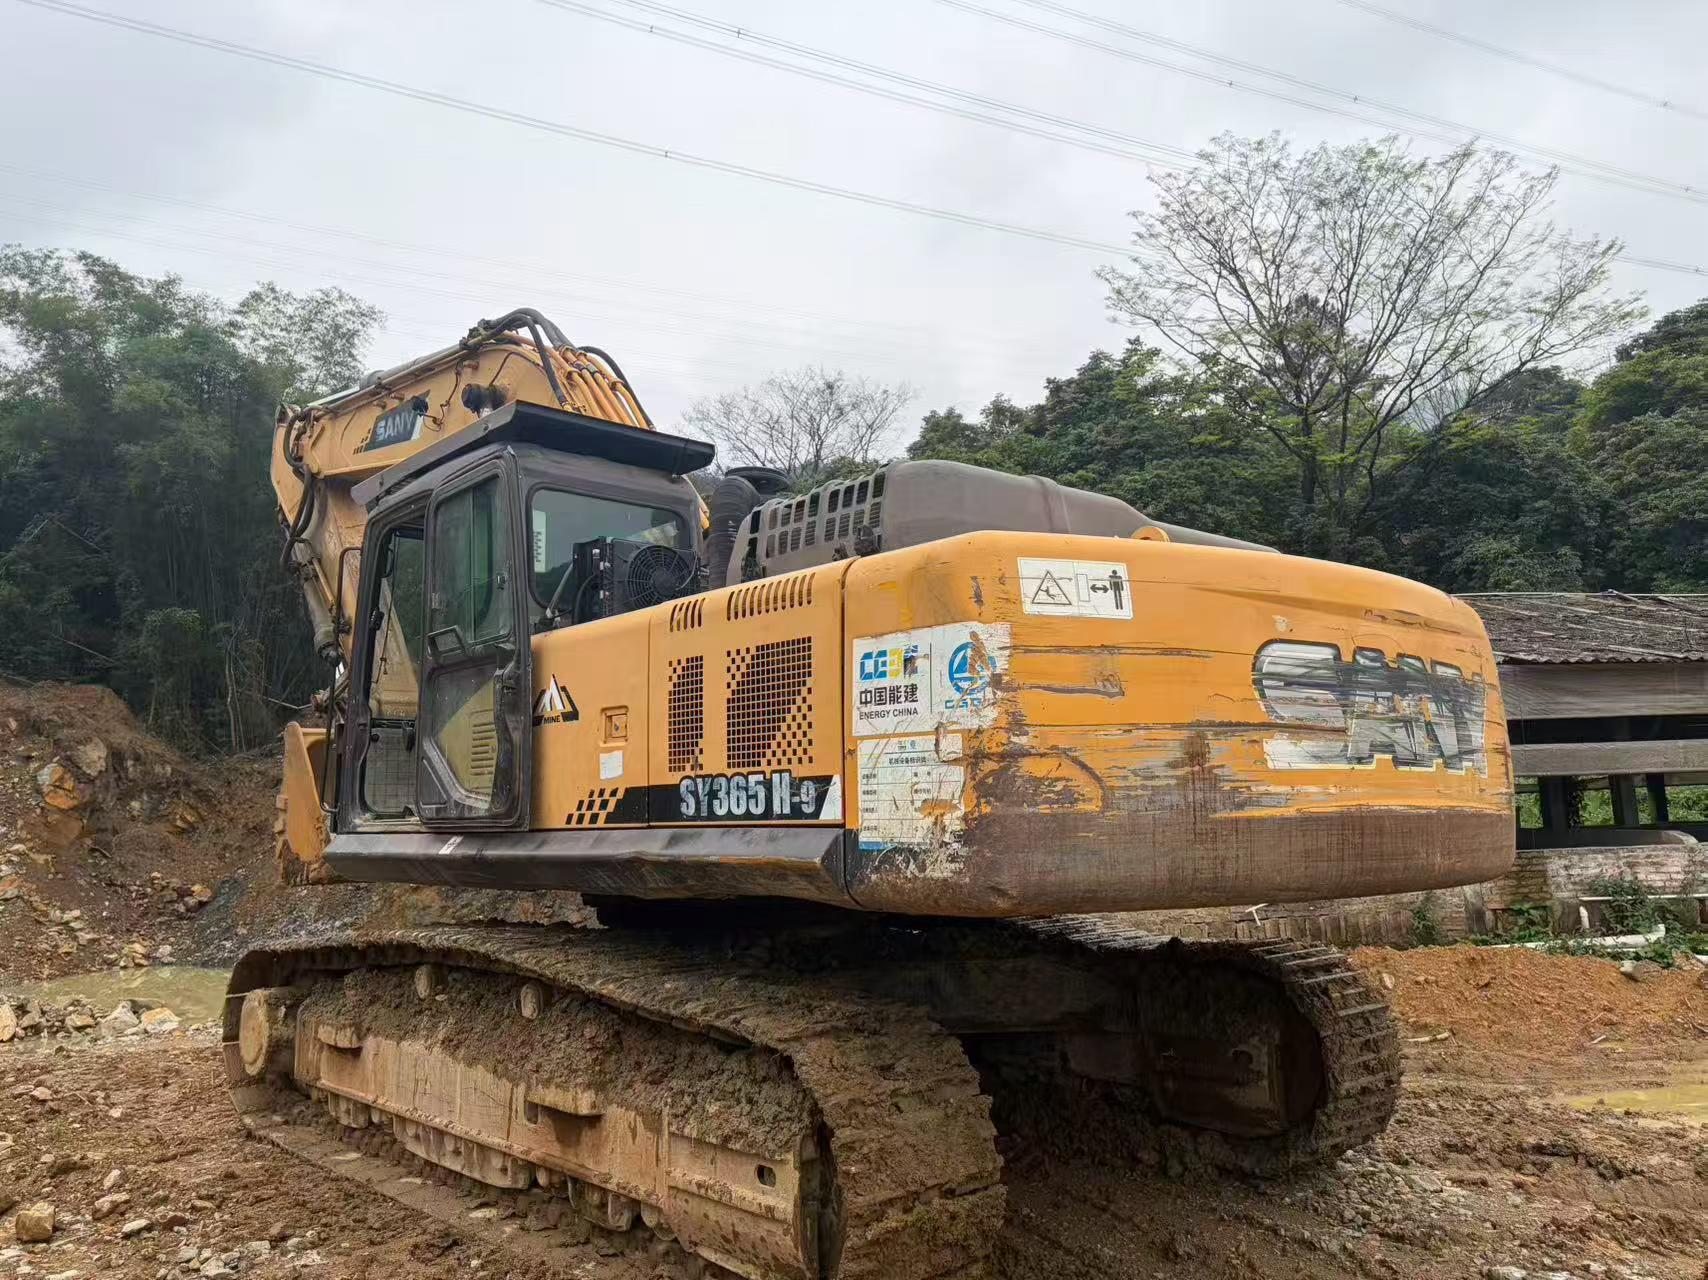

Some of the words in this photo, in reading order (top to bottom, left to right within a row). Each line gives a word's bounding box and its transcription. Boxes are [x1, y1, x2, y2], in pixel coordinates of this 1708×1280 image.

[375, 411, 414, 440] SANY
[859, 683, 919, 707] 中国能建
[543, 715, 561, 725] MINE
[859, 709, 891, 720] ENERGY
[892, 707, 918, 717] CHINA
[679, 774, 766, 816] SY365
